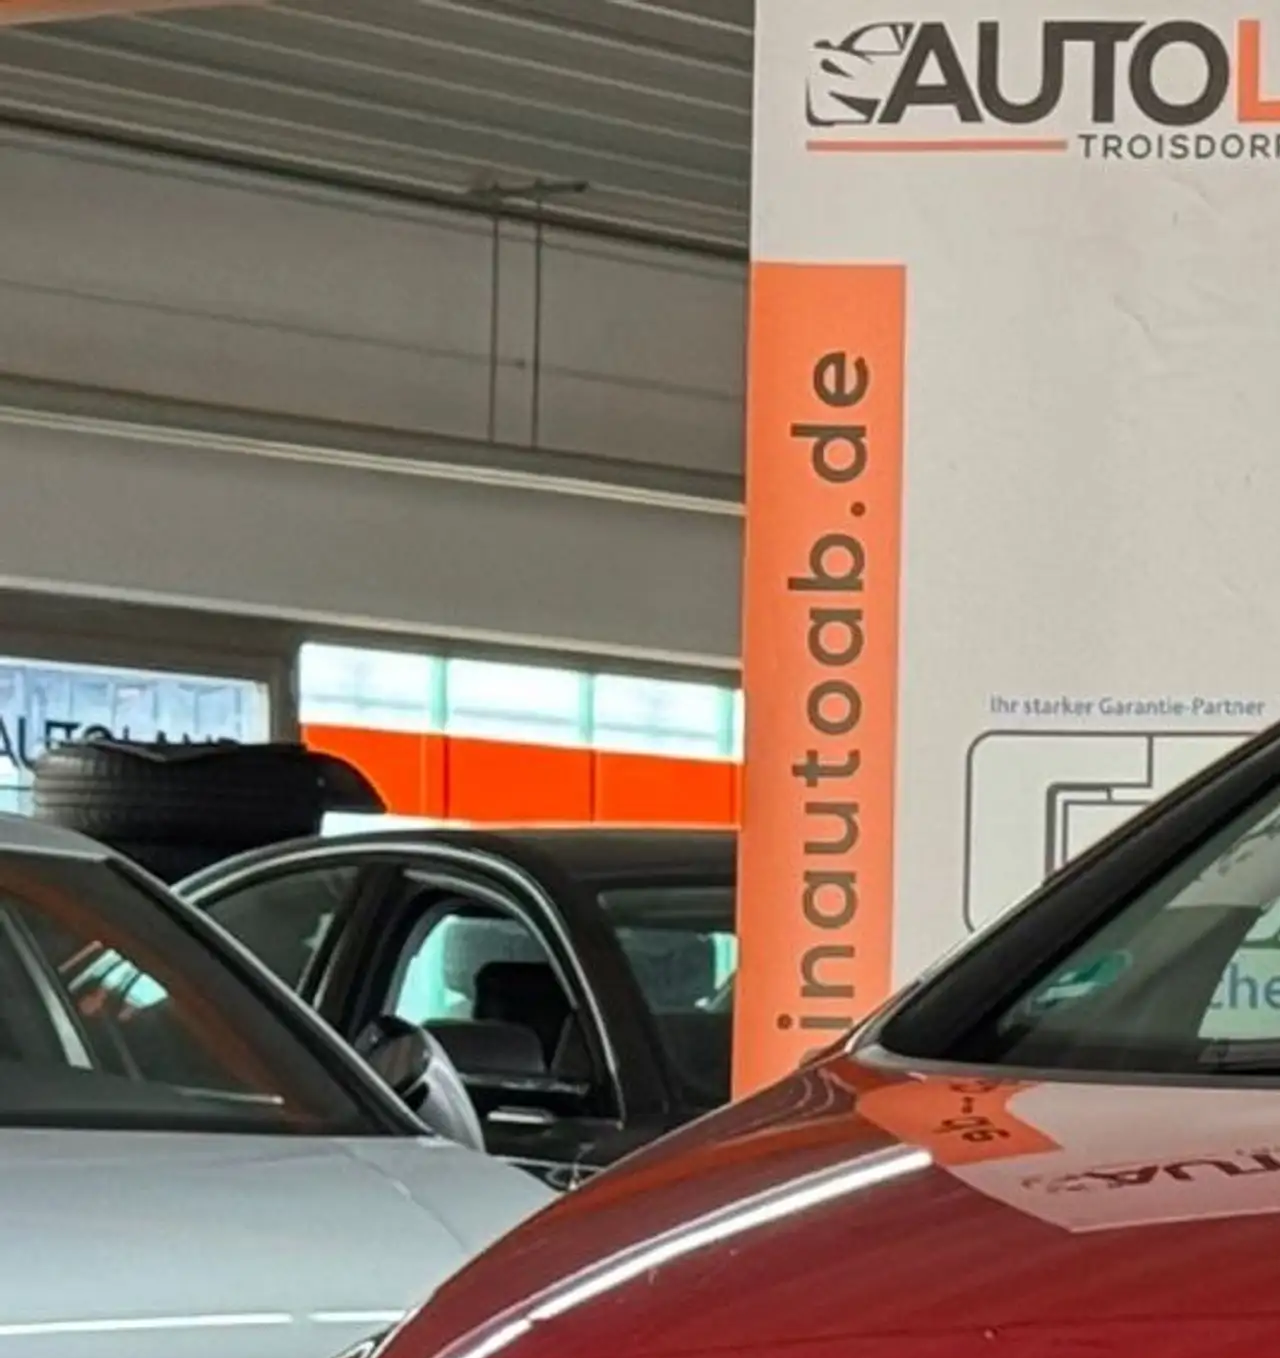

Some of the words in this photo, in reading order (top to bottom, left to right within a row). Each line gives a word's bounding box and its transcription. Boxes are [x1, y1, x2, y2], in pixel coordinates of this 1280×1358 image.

[777, 351, 869, 1068] inautoab.de
[988, 695, 1018, 714] Ihr
[1023, 695, 1093, 715] starker
[1098, 696, 1265, 717] Garantie-Partner
